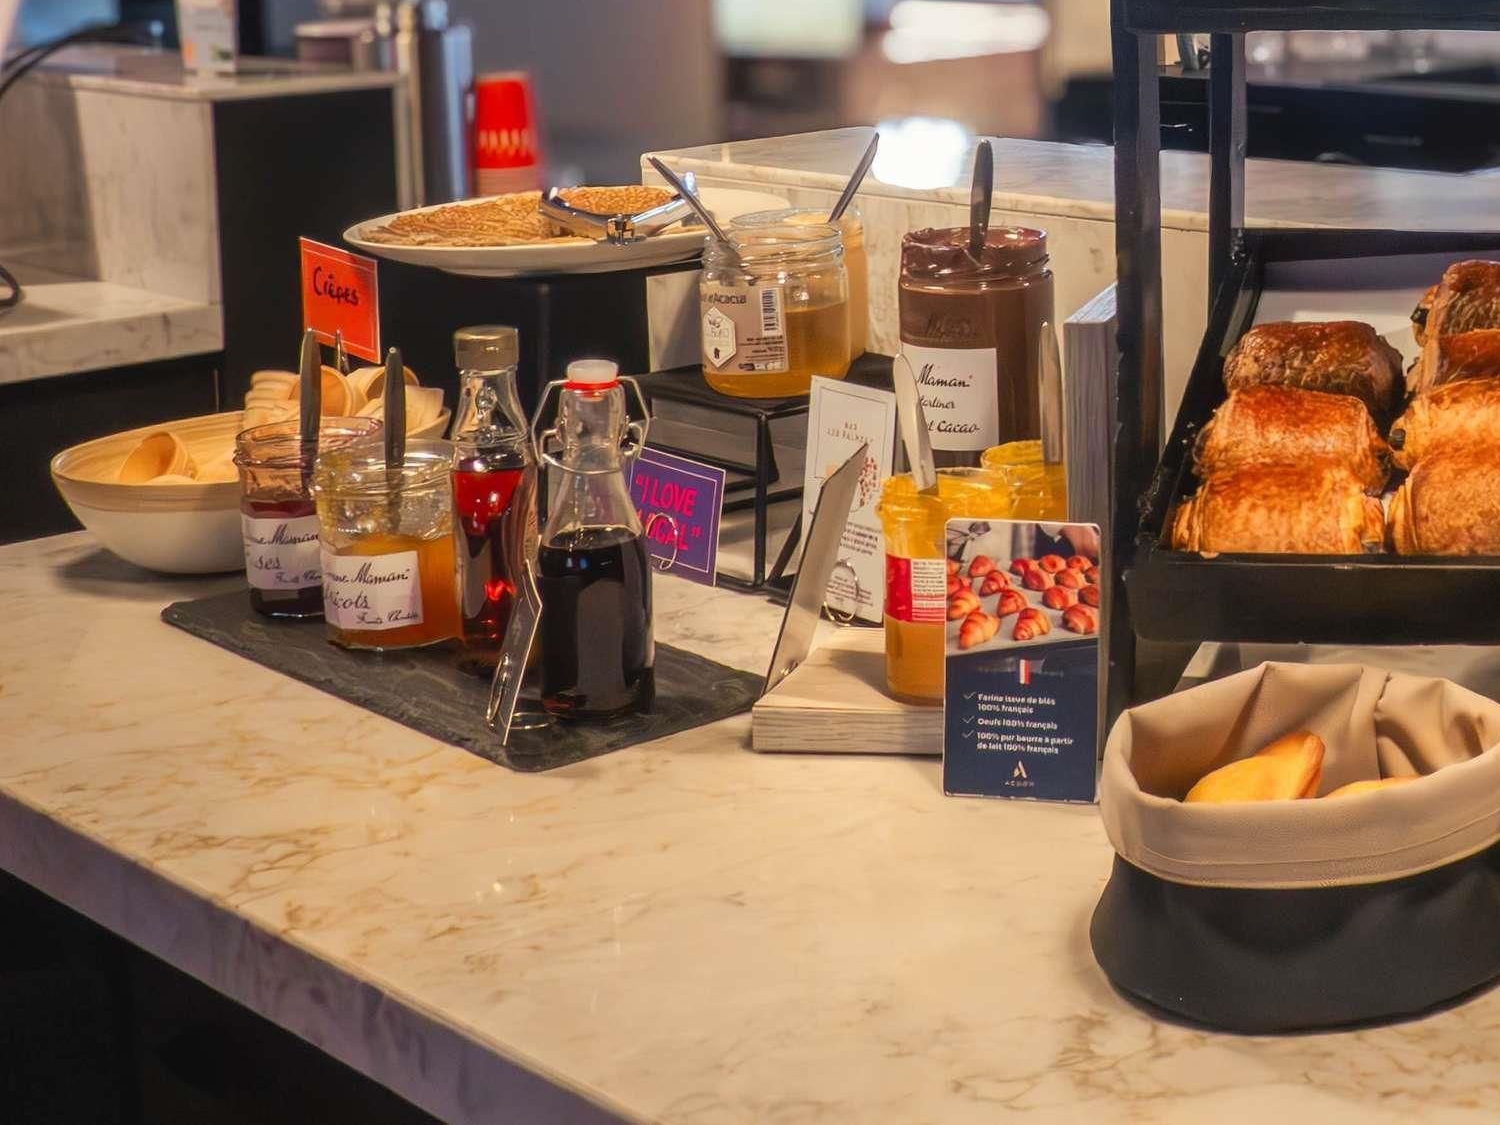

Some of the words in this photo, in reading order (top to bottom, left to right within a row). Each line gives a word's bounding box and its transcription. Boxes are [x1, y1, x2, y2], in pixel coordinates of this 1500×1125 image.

[650, 478, 697, 517] LOVE
[977, 693, 1004, 703] Farine
[1027, 696, 1037, 705] de
[1039, 697, 1056, 706] blés
[977, 703, 1000, 712] 100%
[1002, 705, 1034, 715] français
[977, 732, 999, 741] 100%
[1050, 738, 1073, 746] partir
[976, 742, 988, 750] de
